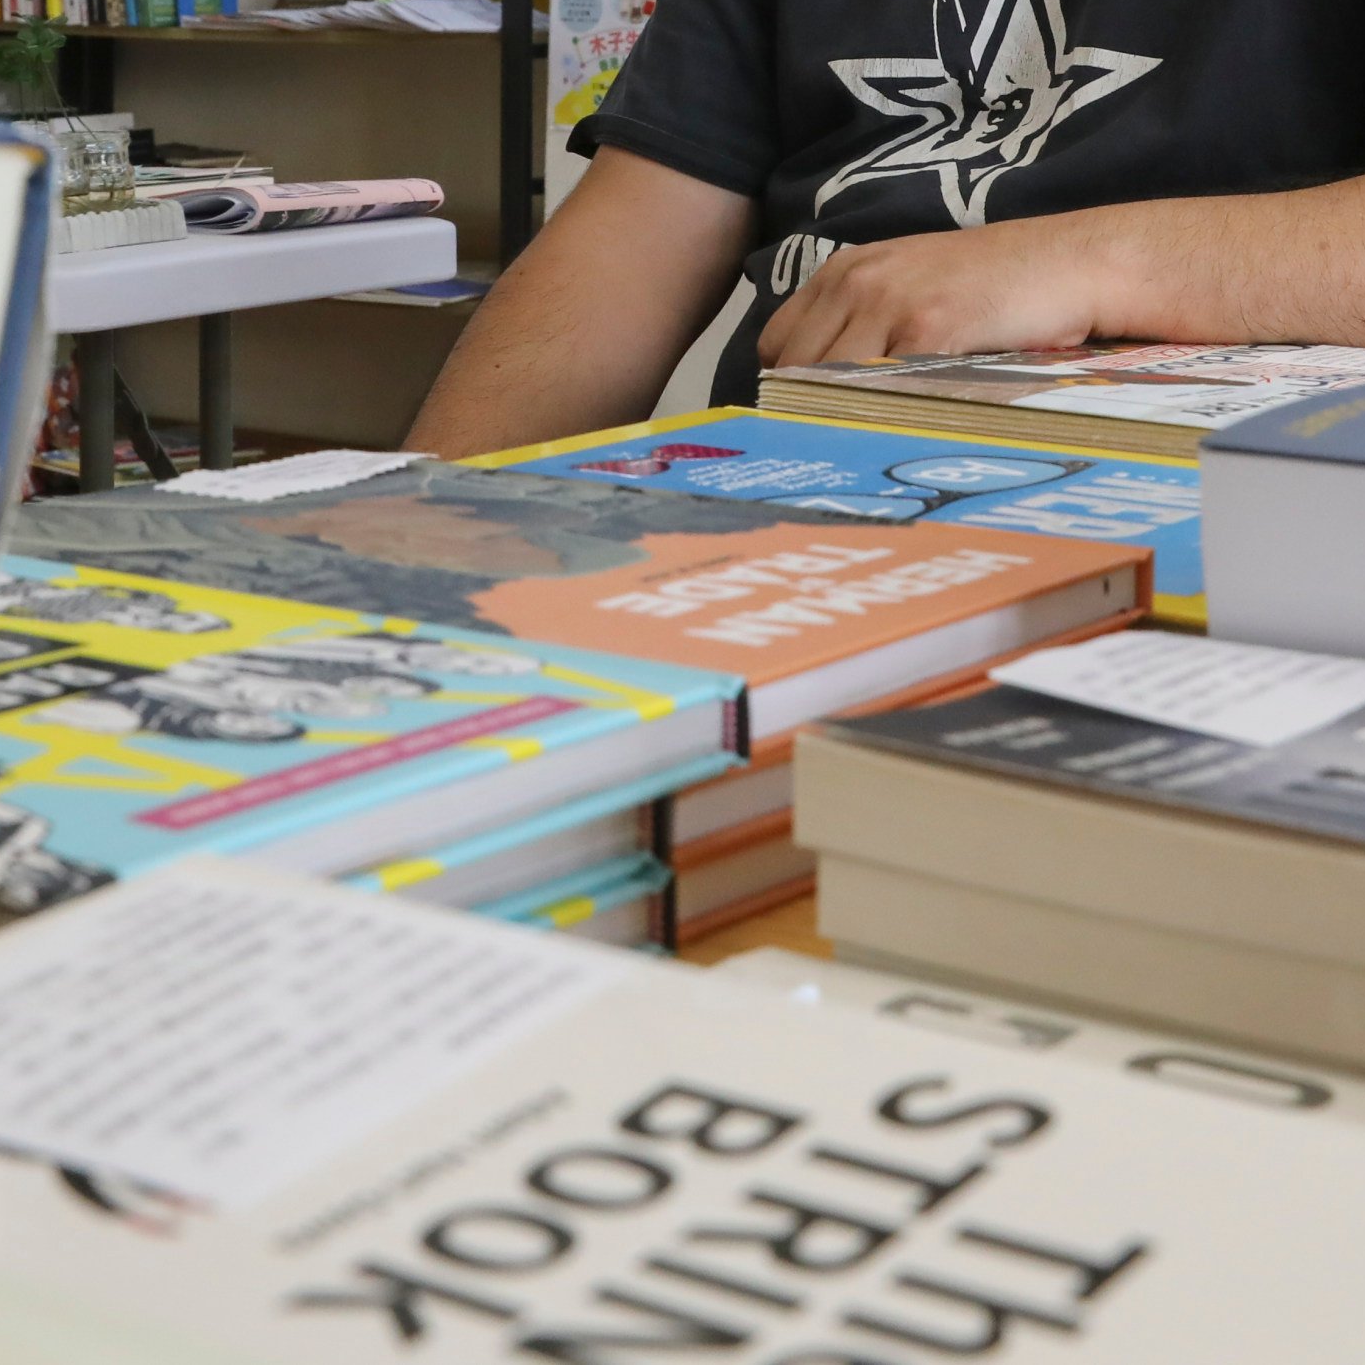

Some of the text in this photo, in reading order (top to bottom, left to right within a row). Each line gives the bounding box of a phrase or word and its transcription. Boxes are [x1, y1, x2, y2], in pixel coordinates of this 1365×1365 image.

[596, 542, 897, 617] TRADE
[686, 544, 1035, 648] HERMAN
[278, 1074, 808, 1348] BOOK
[511, 1074, 1057, 1365] STRIN
